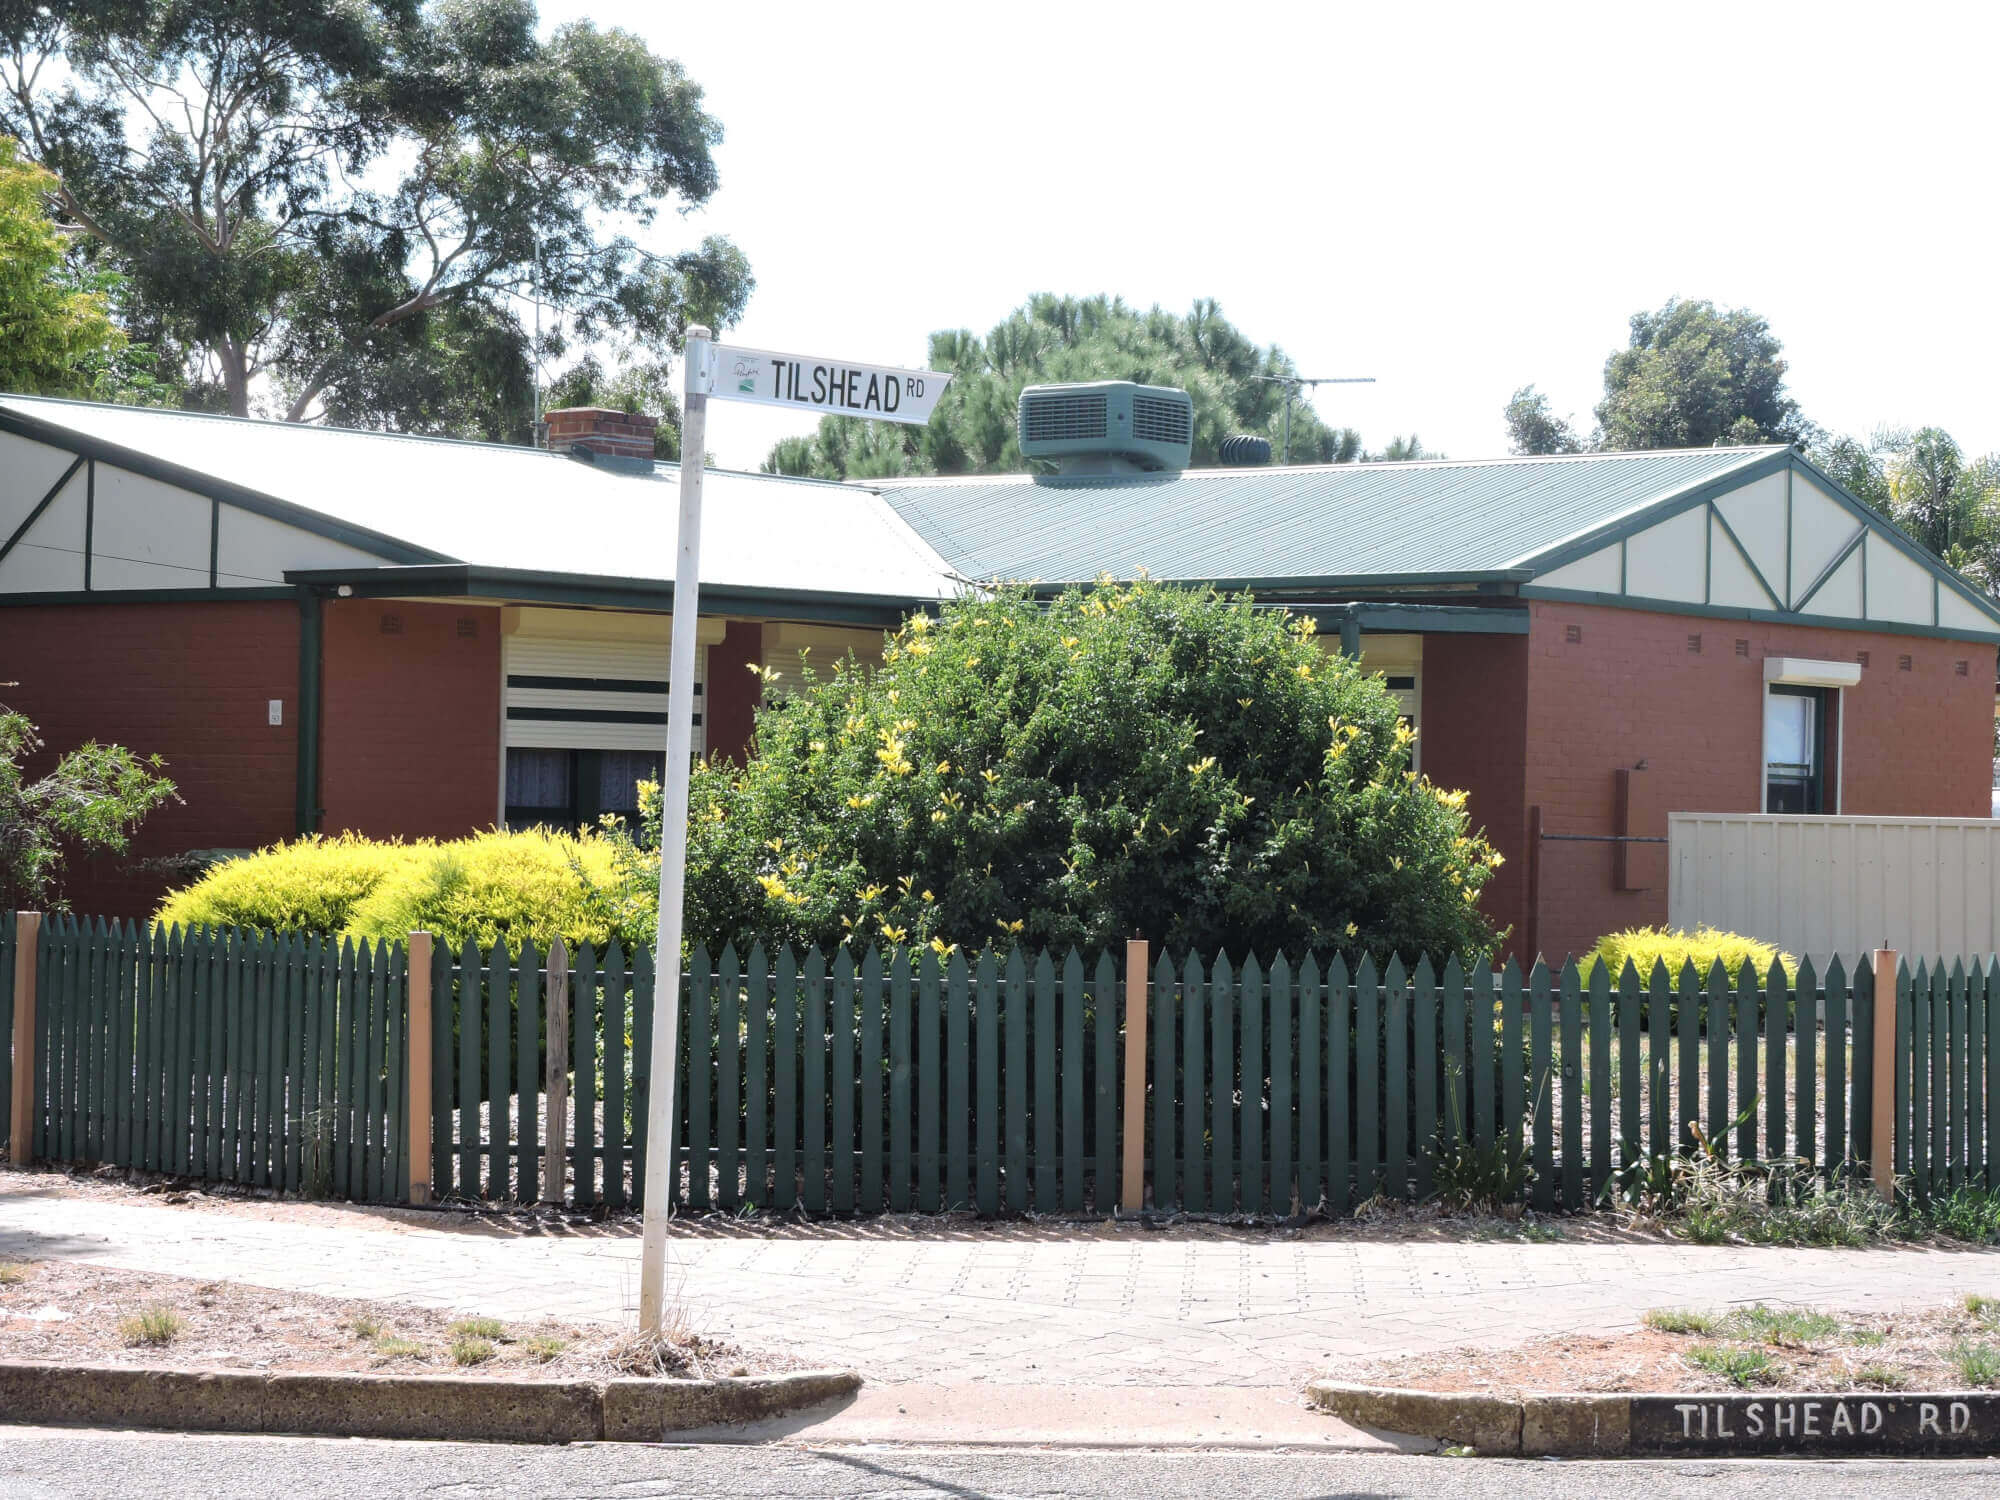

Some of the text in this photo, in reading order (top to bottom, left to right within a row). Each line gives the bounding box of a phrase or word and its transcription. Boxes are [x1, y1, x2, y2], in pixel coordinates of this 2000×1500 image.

[772, 360, 900, 413] TILSHEAD
[906, 378, 925, 398] RD
[1675, 1402, 1971, 1438] TILSHEAD RD
